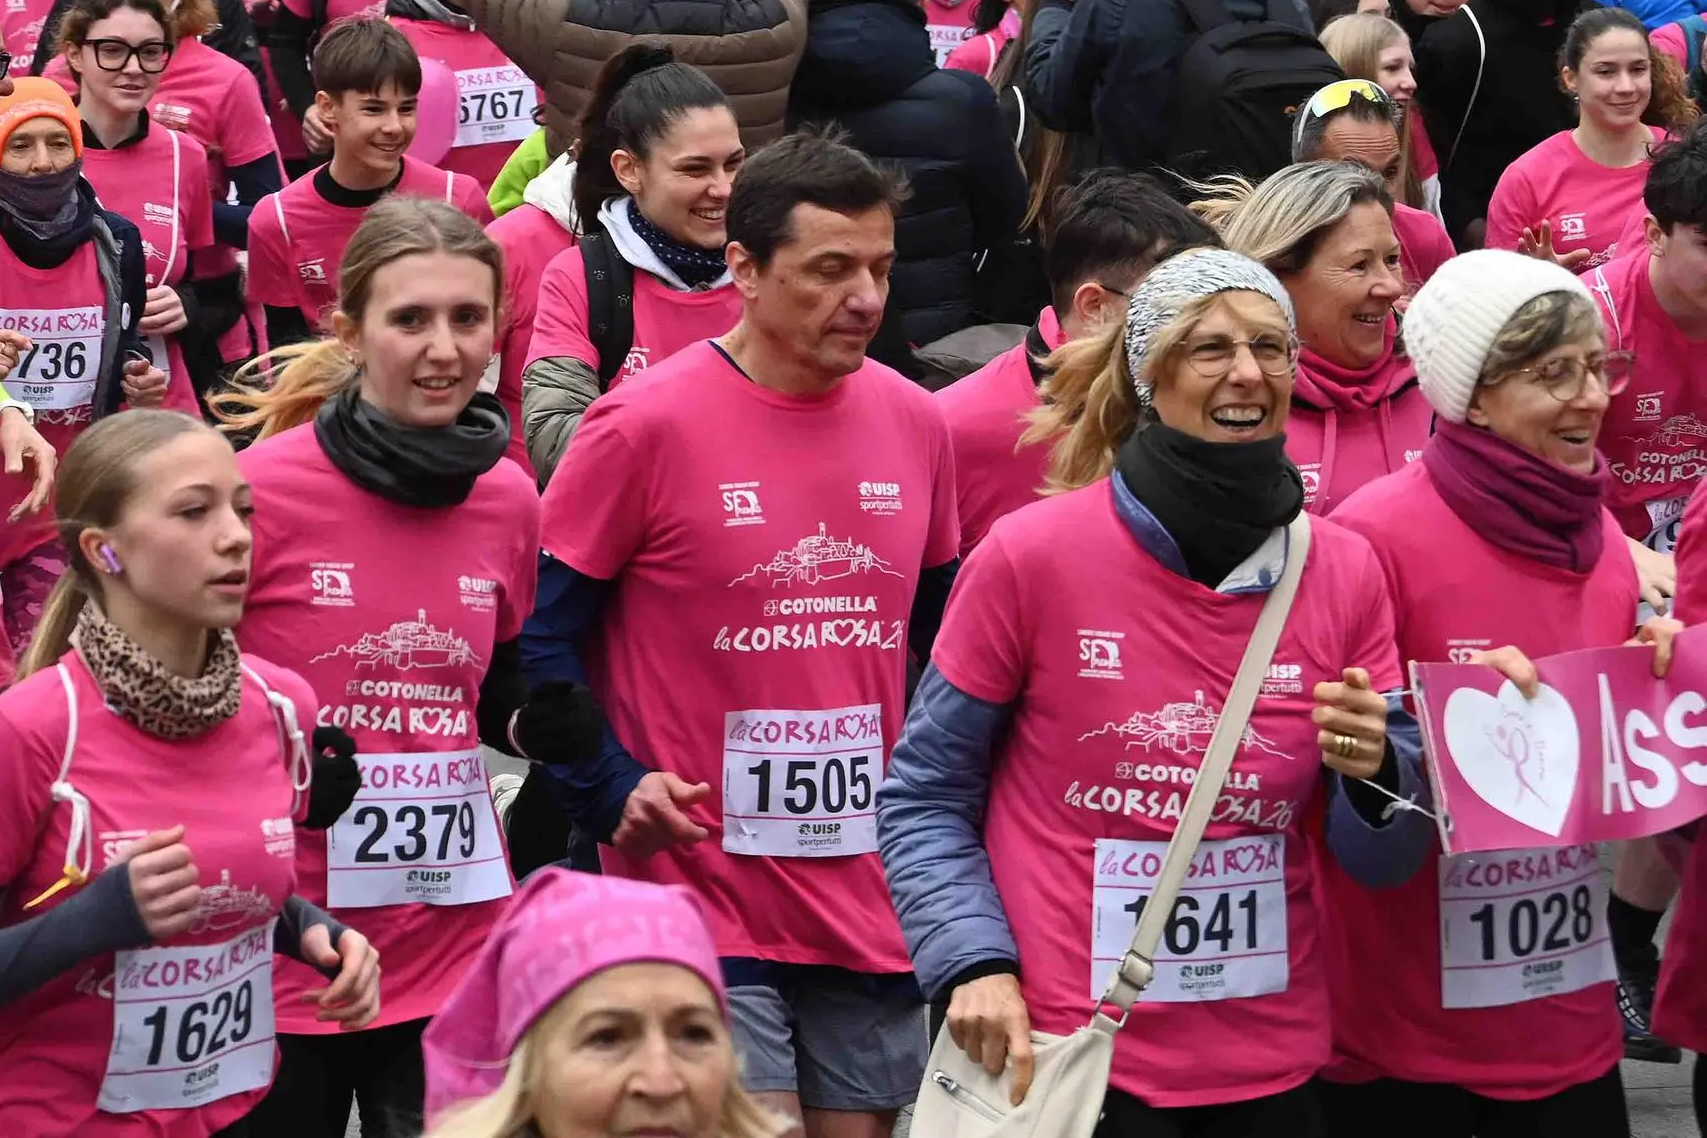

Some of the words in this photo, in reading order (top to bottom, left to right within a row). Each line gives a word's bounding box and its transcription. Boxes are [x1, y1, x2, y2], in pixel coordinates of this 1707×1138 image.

[457, 73, 493, 88] ORSA
[18, 341, 86, 380] 736
[1639, 449, 1707, 464] COTONELL
[873, 482, 900, 497] UISP
[779, 596, 877, 615] COTONELLA
[733, 623, 817, 651] CORSA
[361, 681, 464, 702] COTONELLA
[1259, 680, 1302, 694] tpertutti
[316, 705, 403, 735] CORSA
[749, 717, 831, 745] CORSA
[748, 755, 872, 815] 1505
[1134, 764, 1260, 791] COTOLLA
[1083, 786, 1182, 820] CORSA
[353, 801, 475, 864] 2379
[812, 823, 842, 835] UISP
[420, 871, 451, 883] UISP
[1122, 852, 1215, 879] COSA
[1470, 884, 1592, 961] 1028
[143, 954, 223, 988] CORSA
[1194, 964, 1224, 977] UISP
[144, 980, 252, 1066] 1629
